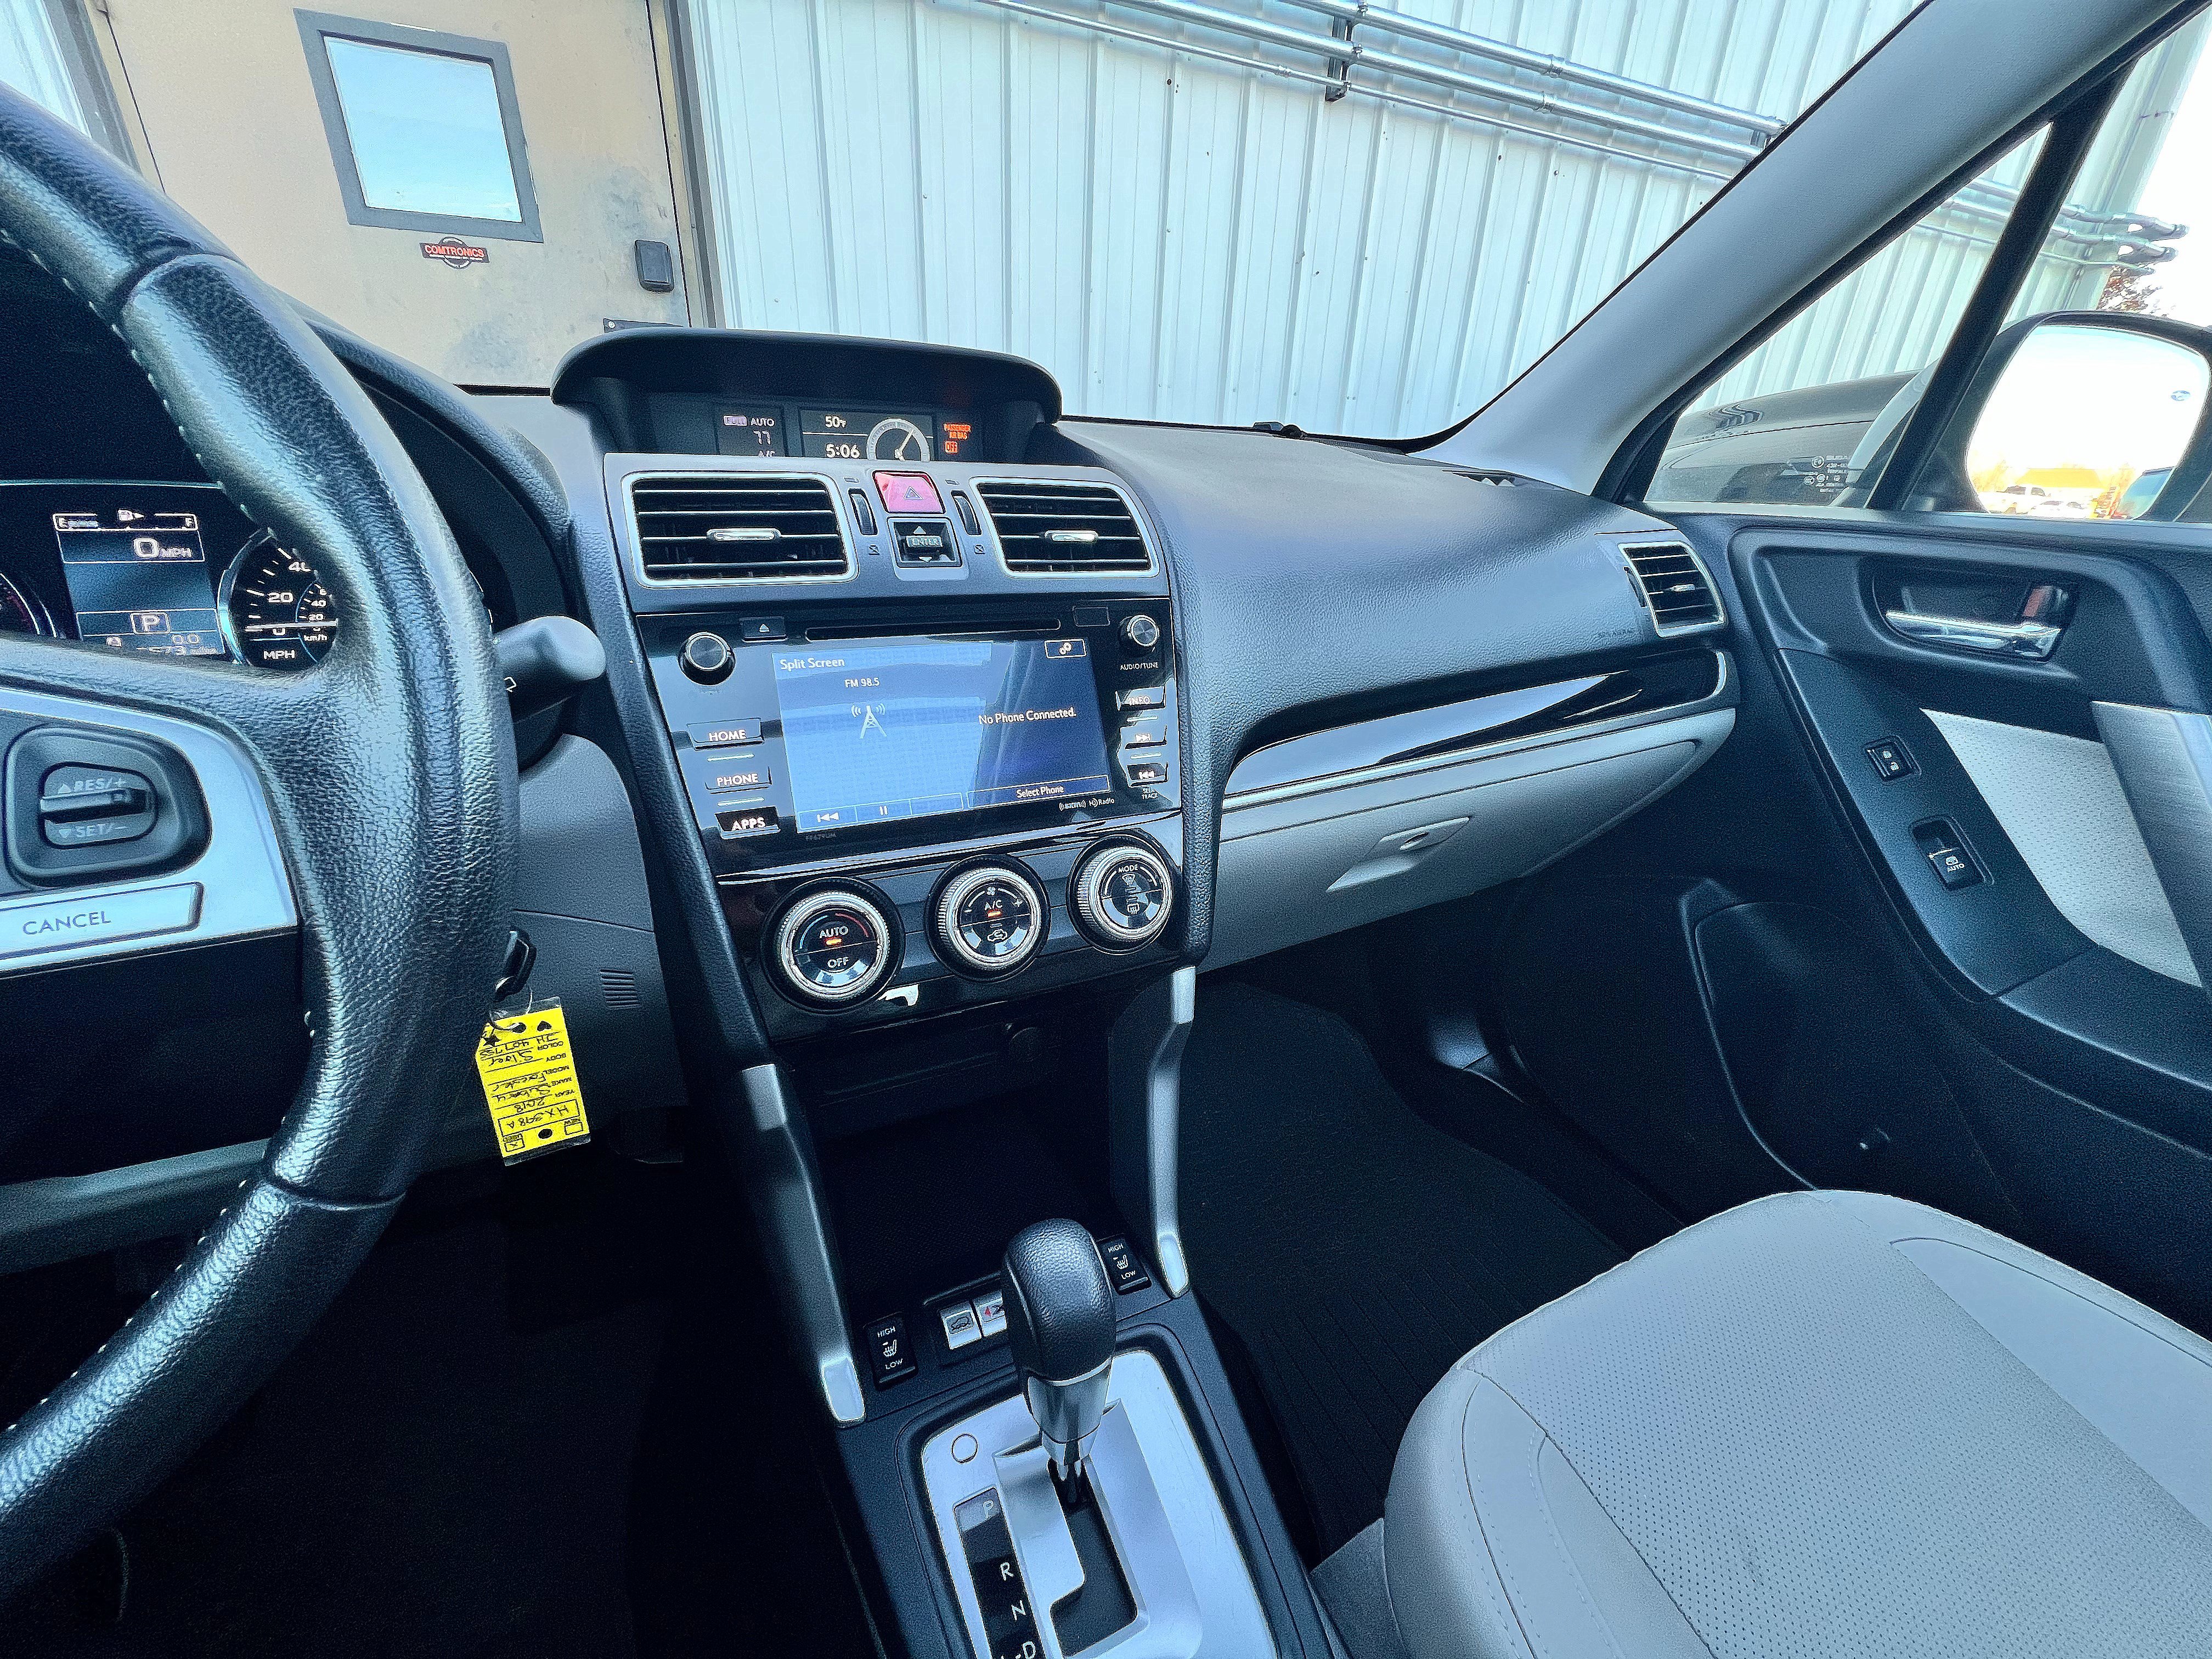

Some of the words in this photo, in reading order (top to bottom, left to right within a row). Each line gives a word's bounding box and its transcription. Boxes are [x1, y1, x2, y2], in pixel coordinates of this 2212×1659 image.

[425, 245, 484, 258] COMTRONICS
[751, 417, 775, 426] AUTO
[826, 443, 860, 458] 5:06
[911, 537, 939, 546] ENTER
[267, 592, 294, 603] 20
[141, 615, 160, 632] P
[171, 633, 200, 645] 0.0
[263, 650, 295, 659] MPH
[779, 659, 806, 672] Split
[808, 657, 845, 668] Screen
[1120, 662, 1159, 670] AUDIO/TUNE
[845, 679, 859, 688] FM
[860, 676, 881, 687] 98.5
[978, 715, 994, 725] No
[995, 713, 1025, 724] Phone
[1025, 706, 1077, 721] Connected.
[708, 729, 746, 742] HOME
[716, 772, 759, 787] PHONE
[1016, 788, 1040, 798] Select
[1040, 785, 1064, 795] Phone
[1098, 797, 1115, 805] Radio
[731, 816, 766, 831] APPS
[1118, 864, 1138, 873] MODE
[1947, 863, 1965, 872] AUTO
[984, 899, 1003, 911] A/C
[22, 911, 111, 935] CANCEL
[819, 926, 849, 939] AUTO
[827, 957, 849, 969] OFF
[537, 1041, 563, 1051] COLOR
[545, 1053, 567, 1062] BODY
[555, 1090, 575, 1098] YEAR
[514, 1097, 545, 1113] 2018
[1108, 1243, 1124, 1253] HIGH
[1121, 1271, 1136, 1279] LOW
[877, 1325, 896, 1338] HIGH
[885, 1358, 903, 1370] LOW
[983, 1499, 995, 1518] P
[1000, 1562, 1014, 1581] R
[1011, 1600, 1026, 1621] N
